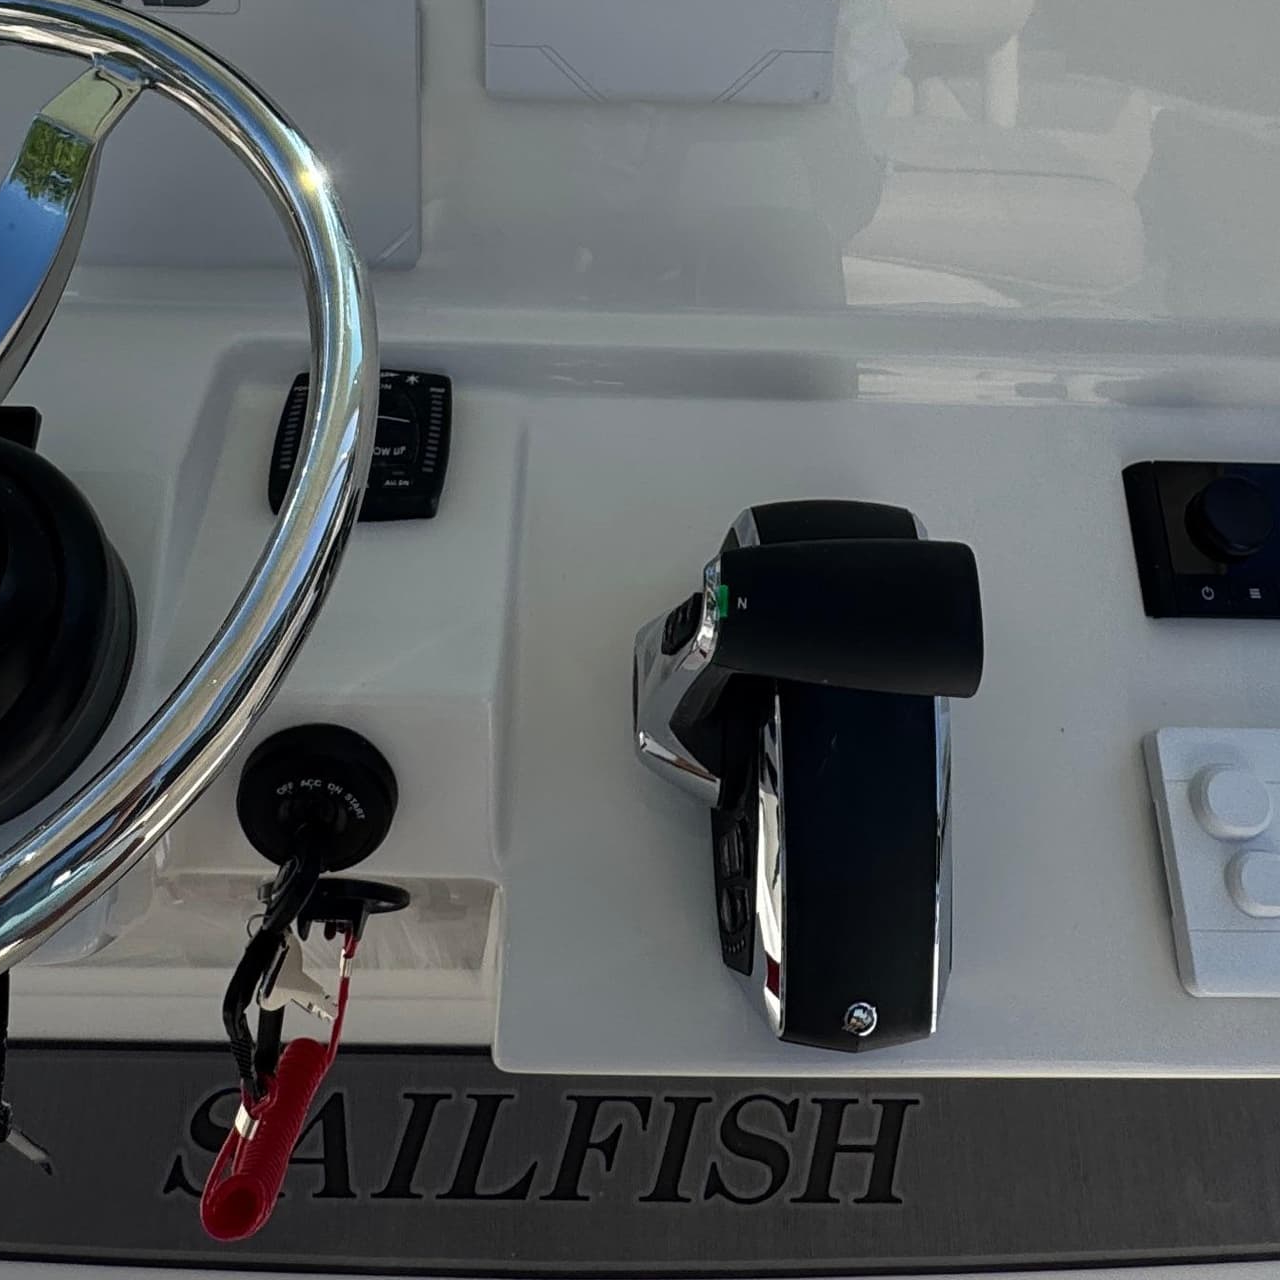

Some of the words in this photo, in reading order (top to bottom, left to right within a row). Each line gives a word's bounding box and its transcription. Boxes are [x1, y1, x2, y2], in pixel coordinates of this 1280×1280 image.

[372, 446, 391, 456] OW
[736, 597, 748, 610] N
[344, 792, 366, 820] START
[163, 1089, 921, 1205] SAILFISH
